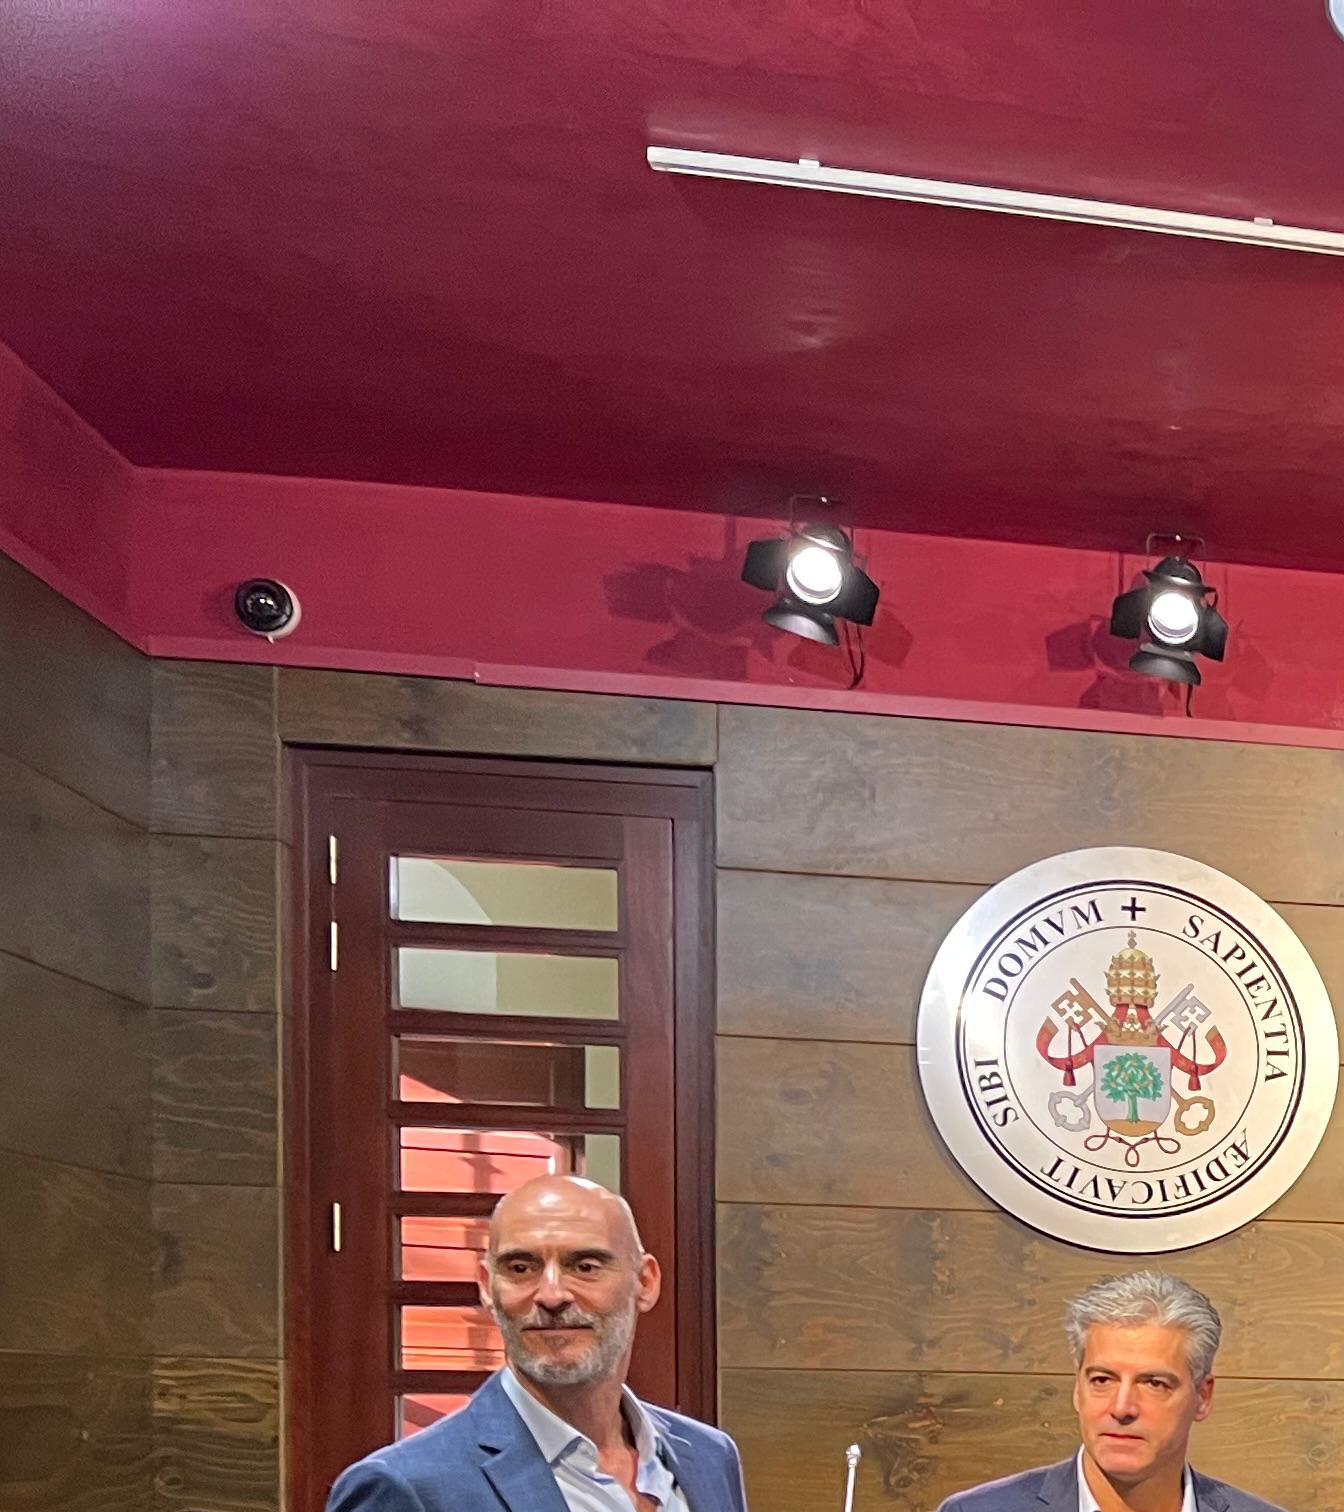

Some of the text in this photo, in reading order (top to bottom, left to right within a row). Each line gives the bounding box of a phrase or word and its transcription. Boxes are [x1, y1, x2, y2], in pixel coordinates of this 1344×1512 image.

[982, 898, 1104, 1003] DOMVM
[1182, 914, 1291, 1084] SAPIENTIA
[973, 1057, 1019, 1128] SIBI
